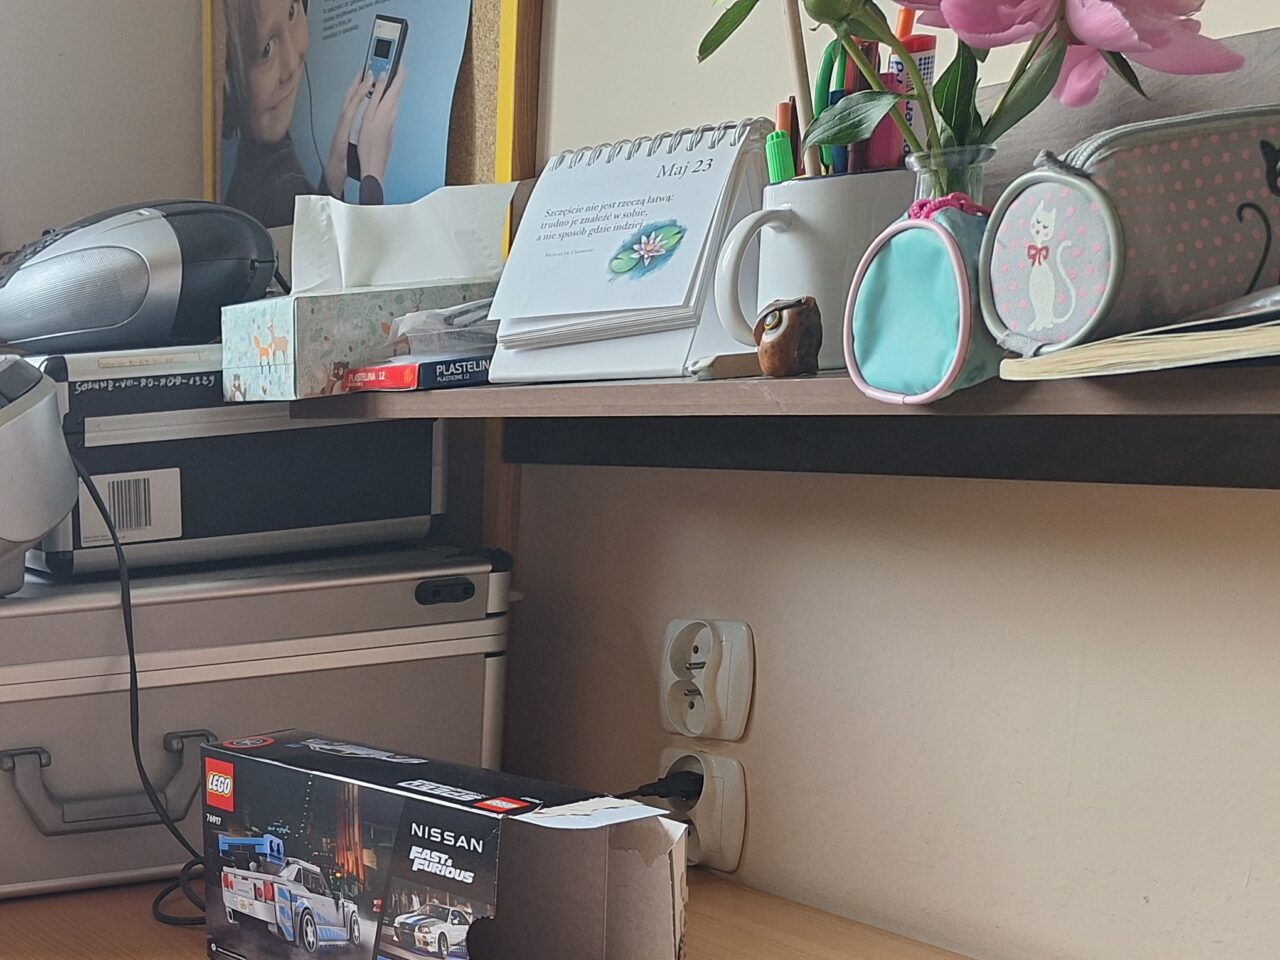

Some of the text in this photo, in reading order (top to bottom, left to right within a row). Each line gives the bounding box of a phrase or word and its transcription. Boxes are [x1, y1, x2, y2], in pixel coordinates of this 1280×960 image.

[656, 158, 714, 180] Maj 23
[544, 205, 584, 218] Szczęście
[585, 203, 599, 213] nie
[598, 201, 616, 214] jest
[617, 197, 646, 208] rzeczą
[540, 208, 649, 230] trudno je znaleźć w sobie,
[542, 231, 557, 241] nie
[557, 226, 587, 242] sposób
[586, 223, 611, 239] gdzie
[348, 370, 385, 383] PLASTELINA 12
[436, 359, 490, 376] PLASTELIN
[208, 773, 231, 795] LEGO
[206, 814, 222, 825] 76917
[411, 822, 484, 853] NISSAN
[409, 846, 453, 866] FAST &
[412, 858, 475, 884] FURIOUS
